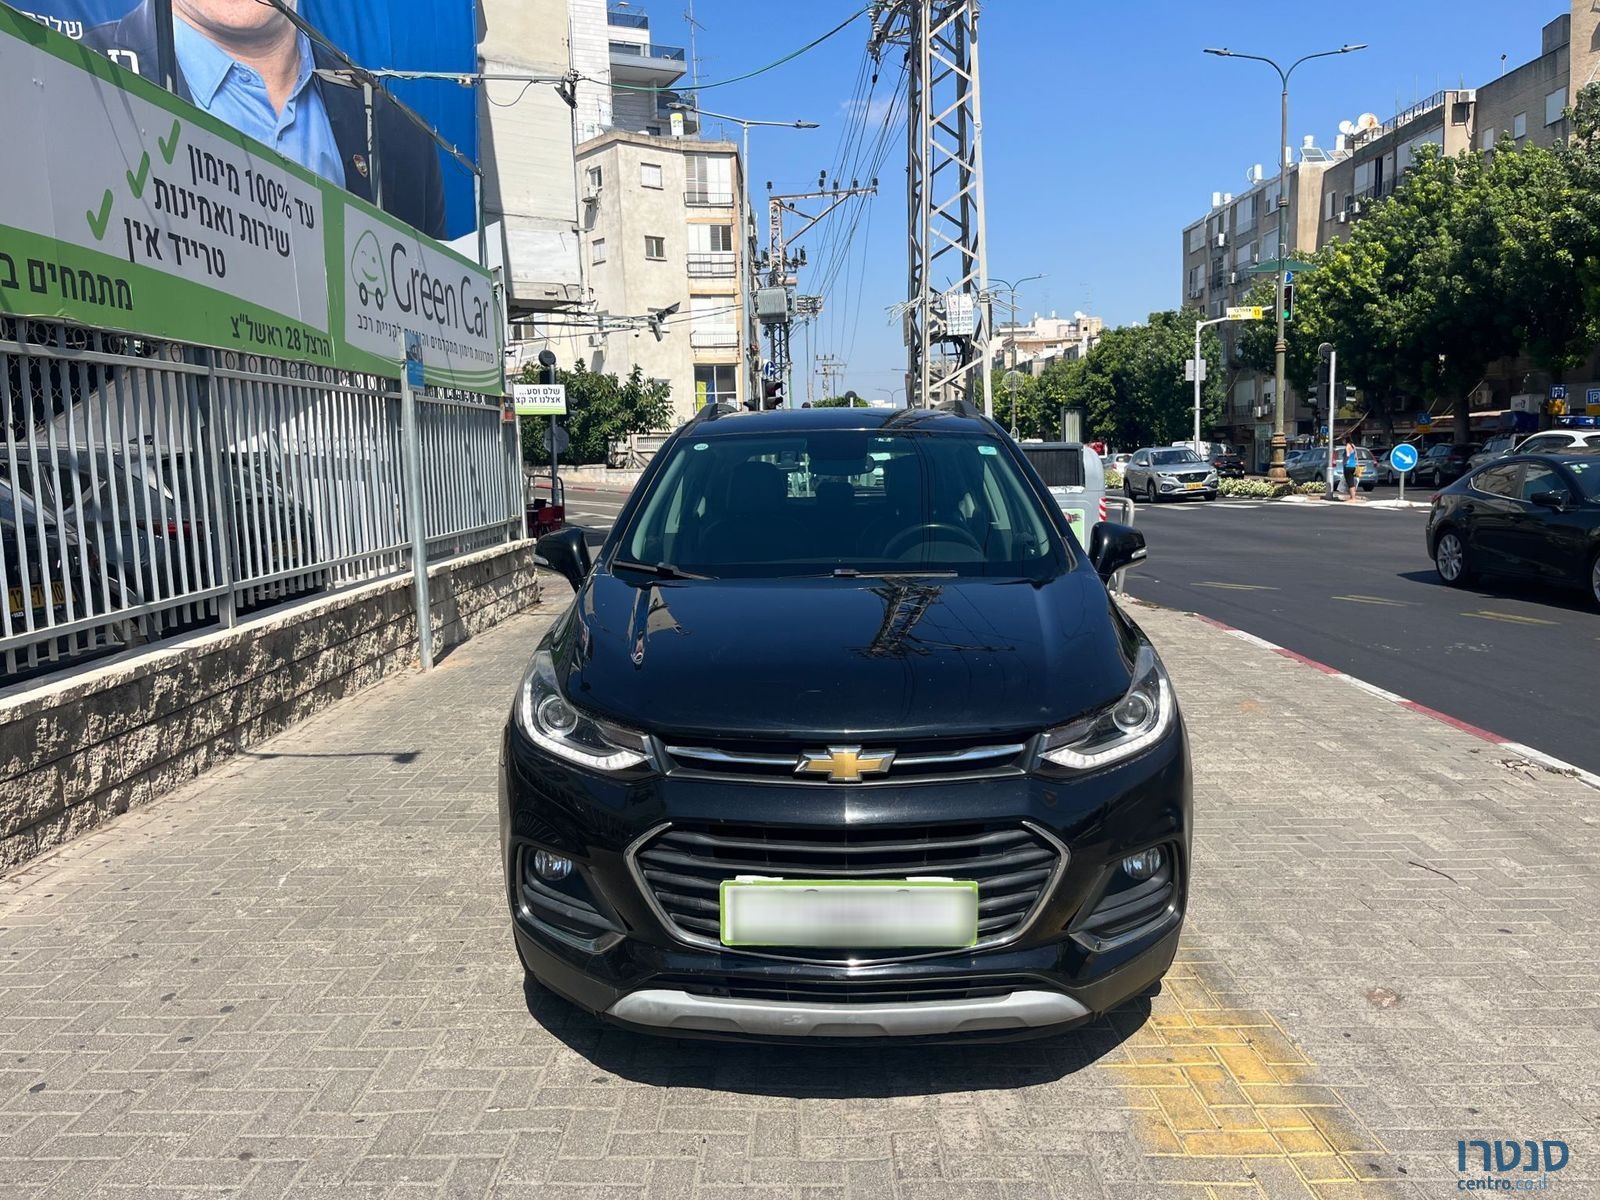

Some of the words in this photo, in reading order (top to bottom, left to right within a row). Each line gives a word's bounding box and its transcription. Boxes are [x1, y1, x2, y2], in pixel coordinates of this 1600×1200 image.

[187, 143, 240, 196] מימון
[153, 176, 235, 237] ואמינות
[245, 169, 292, 219] 100%
[294, 197, 315, 230] עד
[123, 217, 163, 263] אין
[167, 231, 226, 279] טרייד
[239, 212, 290, 258] שירות
[27, 258, 133, 311] מתמחים
[390, 242, 459, 329] Green
[460, 275, 489, 339] Car
[230, 313, 283, 347] ראשל"צ
[285, 326, 302, 351] 28
[303, 328, 331, 358] הרצל
[356, 313, 374, 332] רכב
[539, 395, 561, 404] אצלנו
[542, 386, 561, 395] שלם
